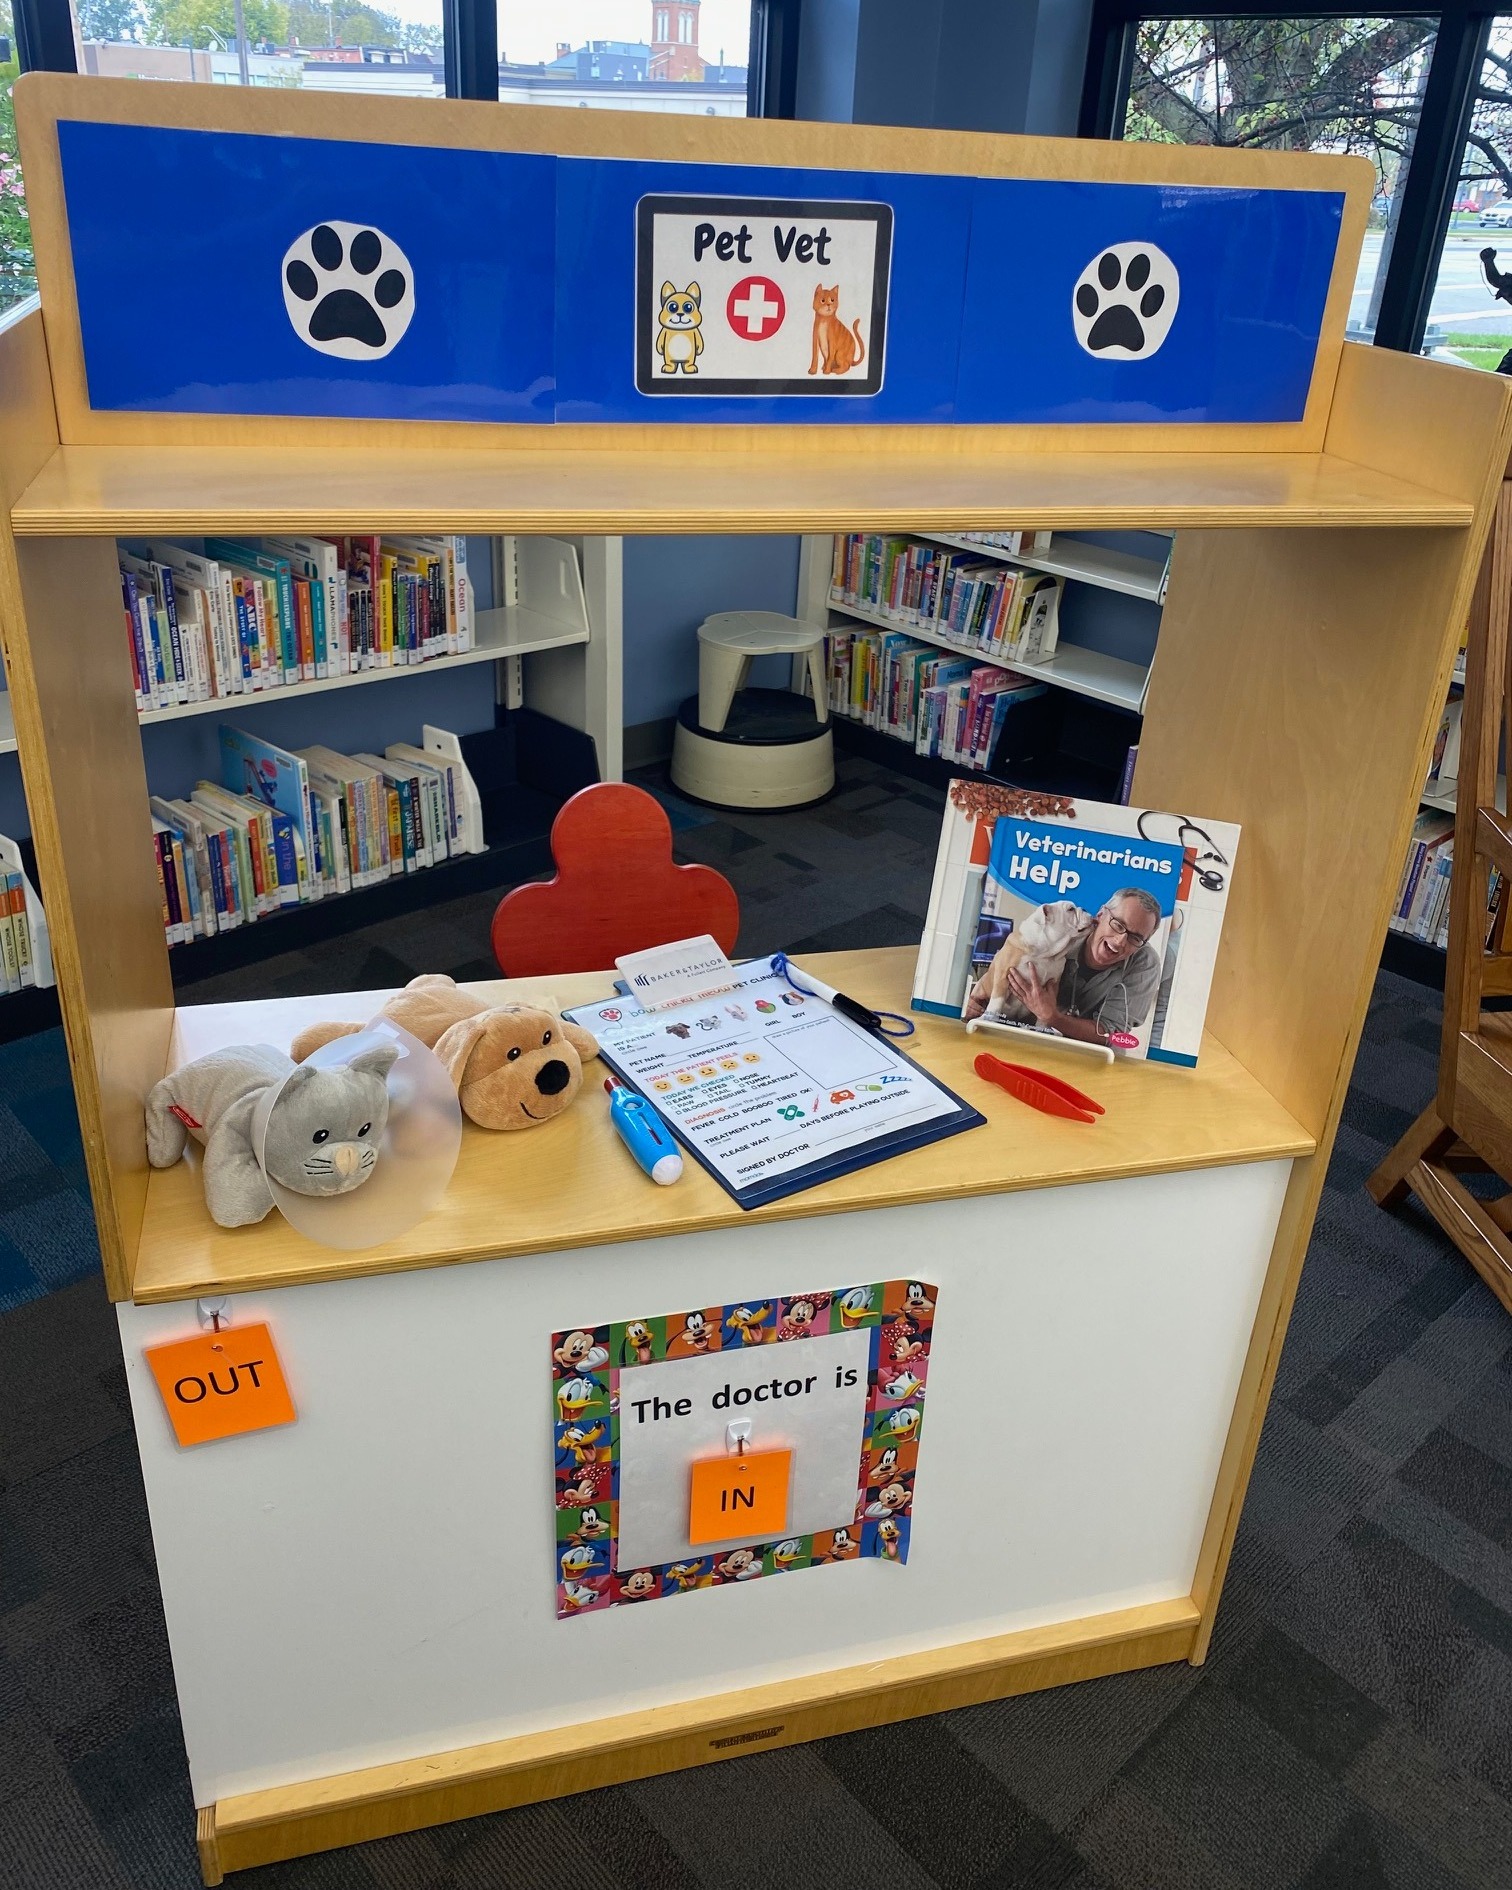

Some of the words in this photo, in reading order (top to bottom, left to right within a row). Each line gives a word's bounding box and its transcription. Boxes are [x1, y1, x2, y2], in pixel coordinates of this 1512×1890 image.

[694, 222, 753, 264] Pet
[773, 224, 832, 266] Vet
[458, 578, 466, 612] Ocean
[247, 604, 257, 633] ABC
[256, 608, 264, 617] My
[392, 835, 400, 856] trucks
[404, 811, 414, 850] JAPANESE
[282, 842, 290, 850] in
[1014, 829, 1173, 875] Veterinarians
[283, 853, 294, 870] the
[1008, 854, 1081, 895] Help
[1422, 865, 1430, 879] Shapes
[7, 948, 15, 968] TOOLS?
[650, 958, 723, 983] BAKER&TAYLOR
[706, 965, 726, 976] Company
[628, 1006, 656, 1018] bow
[732, 980, 748, 990] PET
[749, 972, 780, 985] CLINIC
[613, 1039, 626, 1048] MY
[626, 1032, 656, 1044] PATIENT
[1111, 1036, 1137, 1046] Pebble
[628, 1059, 643, 1068] PET
[643, 1053, 667, 1064] NAME
[636, 1062, 664, 1075] WEIGHT
[687, 1041, 738, 1059] TEMPERATURE
[644, 1071, 670, 1083] TODAY
[670, 1068, 686, 1078] THE
[686, 1060, 716, 1072] PATIENT
[716, 1052, 739, 1062] FEELS
[660, 1091, 687, 1101] TODAY
[687, 1086, 699, 1094] WE
[699, 1074, 736, 1090] CHECKED
[672, 1094, 694, 1104] EARS
[708, 1082, 728, 1093] EYES
[738, 1072, 760, 1083] NOSE
[676, 1100, 695, 1109] PAW
[714, 1088, 731, 1098] TAIL
[745, 1074, 772, 1087] TUMMY
[682, 1100, 708, 1114] BLOOD
[708, 1088, 748, 1104] PRESSURE
[756, 1072, 799, 1090] HEARTBEAT
[684, 1107, 726, 1125] DIAGNOSIS
[690, 1120, 719, 1132] FEVER
[718, 1111, 740, 1122] COLD
[741, 1100, 774, 1114] BOOBOO
[776, 1092, 798, 1102] TIRED
[720, 1145, 751, 1159] PLEASE
[750, 1136, 770, 1148] WAIT
[800, 1118, 821, 1129] DAYS
[820, 1108, 850, 1122] BEFORE
[849, 1098, 880, 1112] PLAYING
[880, 1089, 911, 1102] OUTSIDE
[704, 1125, 750, 1145] TREATMENT
[750, 1117, 772, 1128] PLAN
[736, 1161, 766, 1175] SIGNED
[766, 1156, 778, 1165] BY
[777, 1143, 811, 1159] DOCTOR
[174, 1360, 264, 1404] OUT
[631, 1396, 692, 1425] The
[711, 1374, 817, 1410] doctor
[835, 1365, 858, 1389] is
[720, 1485, 755, 1513] IN
